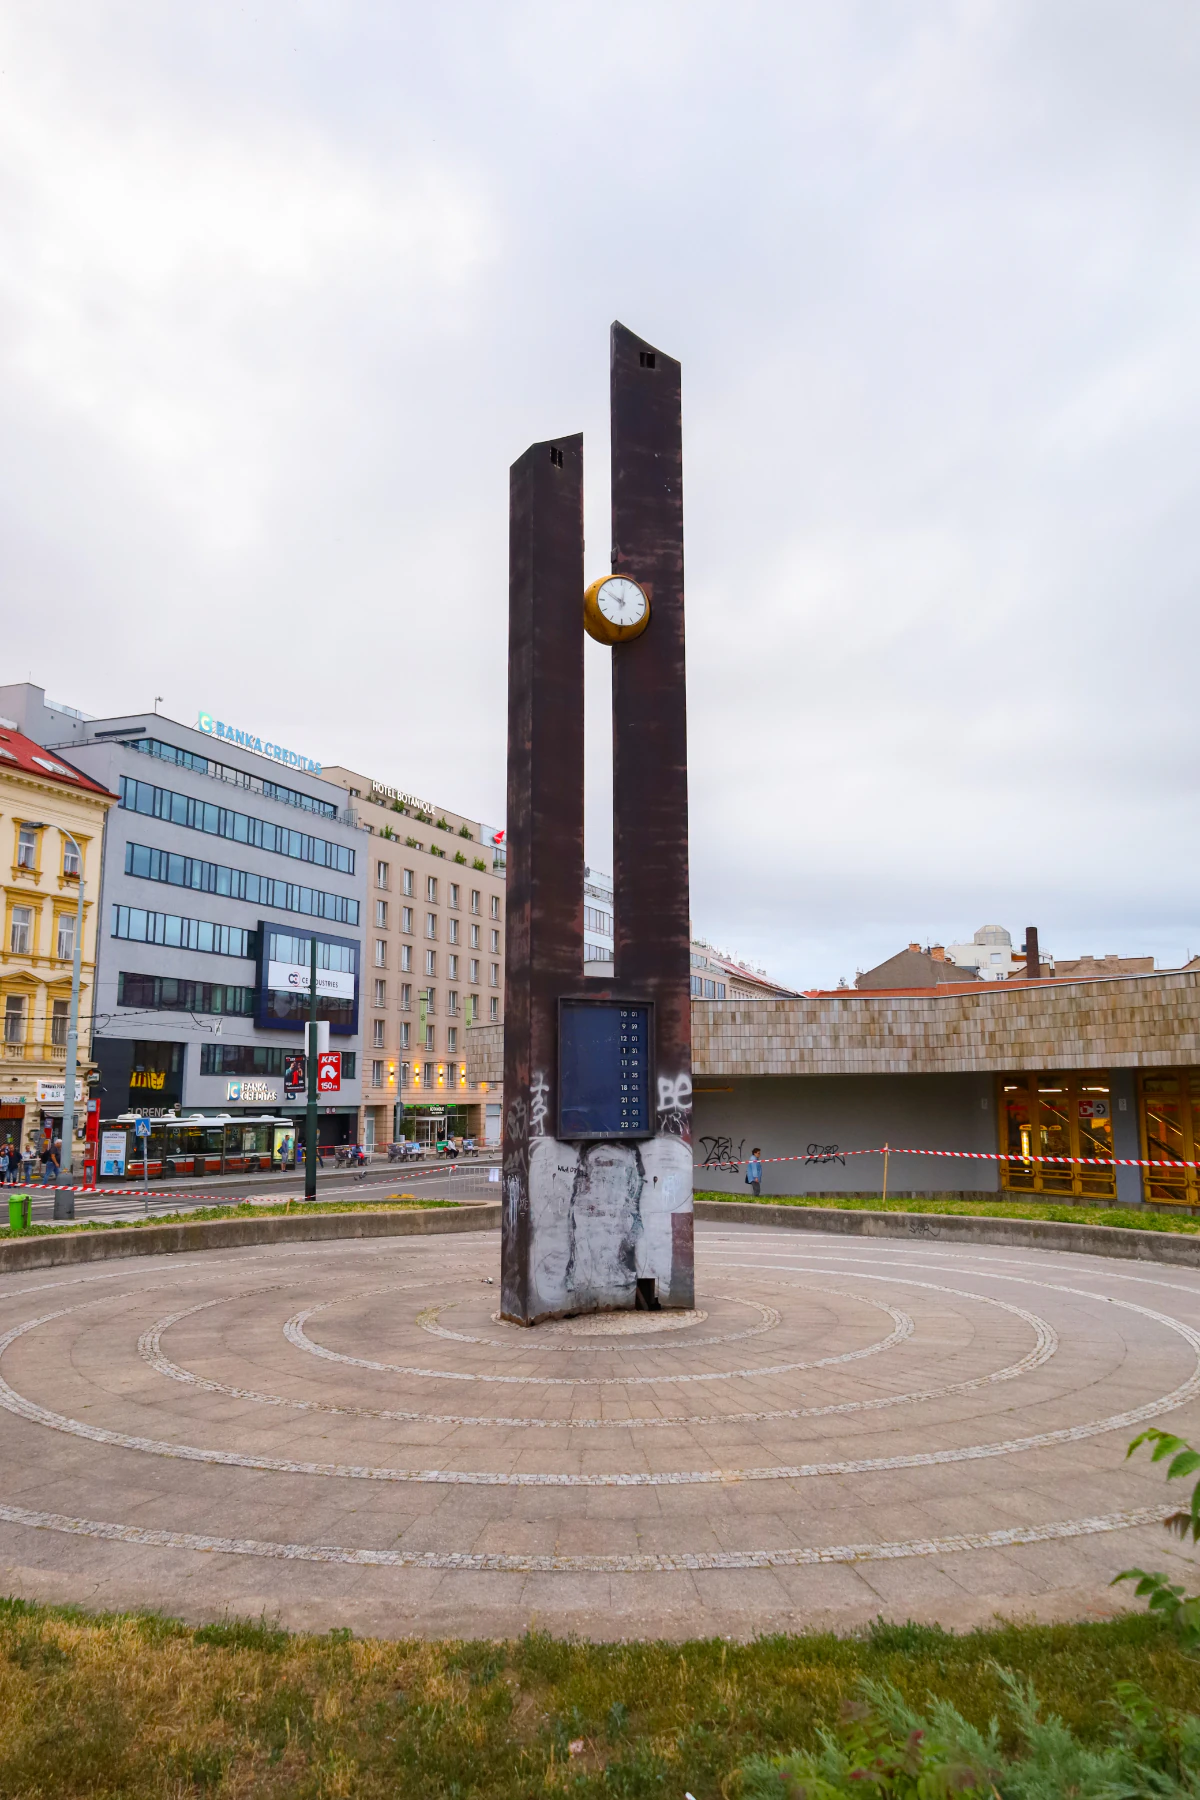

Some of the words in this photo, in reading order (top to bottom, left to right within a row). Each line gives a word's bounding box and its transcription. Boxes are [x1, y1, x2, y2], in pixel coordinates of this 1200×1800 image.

[216, 721, 263, 753] BANKA
[264, 742, 323, 776] CREDITAS
[372, 780, 396, 799] HOTEL
[397, 791, 436, 815] BOTANIQUE
[310, 979, 339, 988] DUSTRIES
[321, 1055, 339, 1064] KFC
[241, 1082, 268, 1092] BANKA
[321, 1081, 333, 1090] 150
[240, 1091, 278, 1101] CREDITAS
